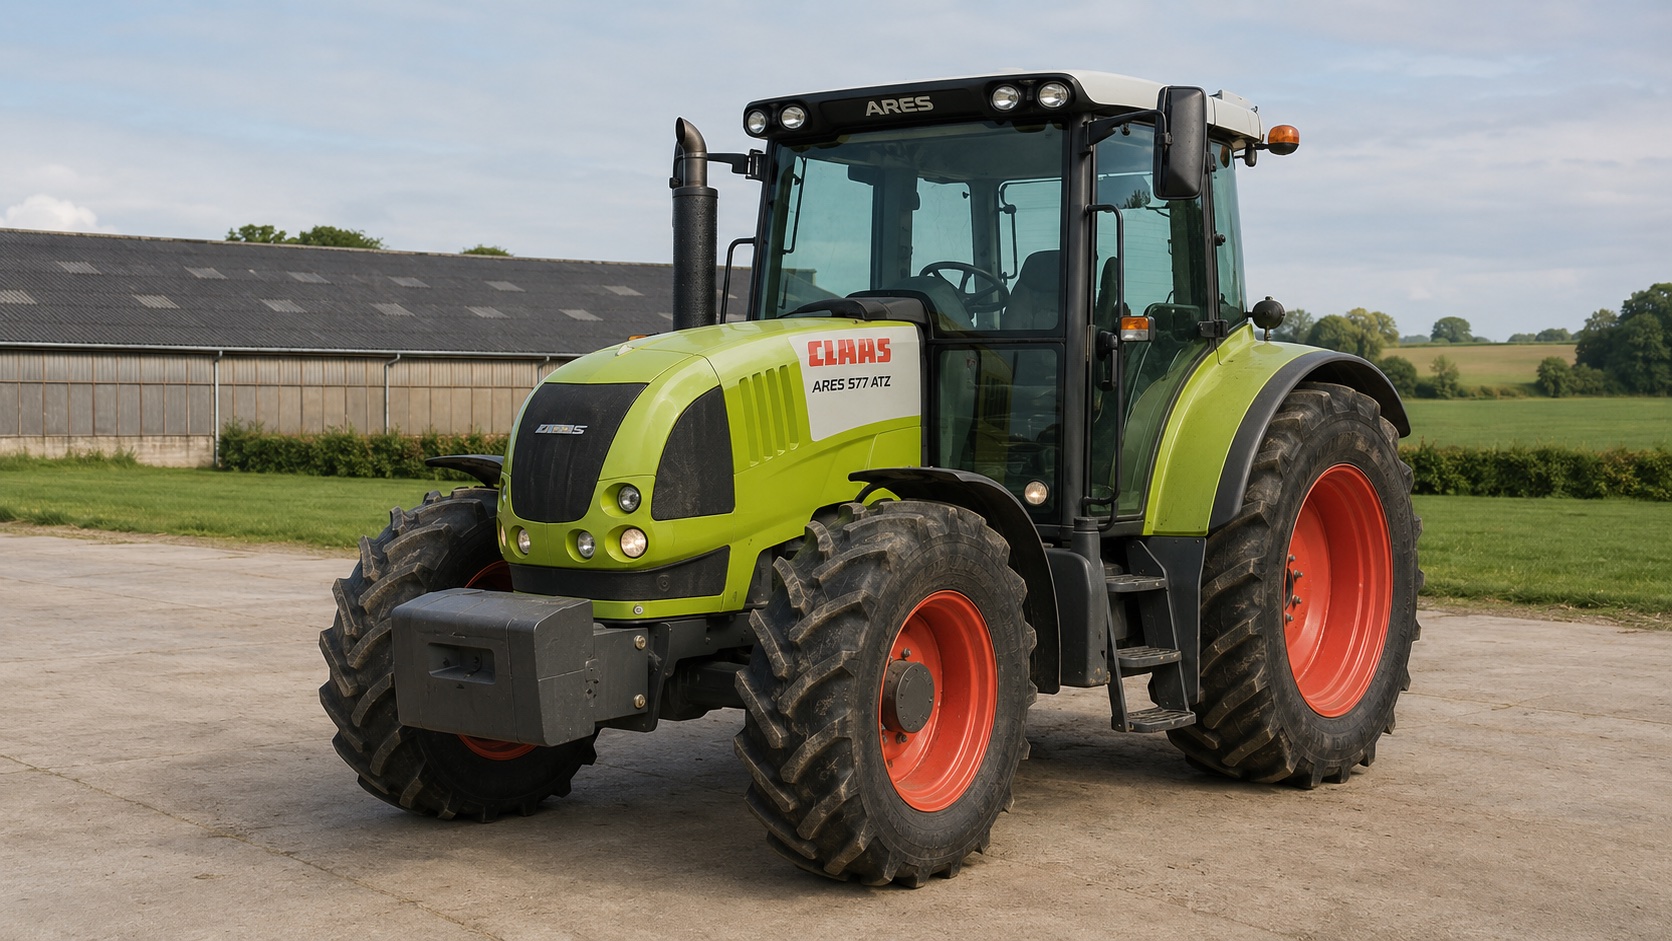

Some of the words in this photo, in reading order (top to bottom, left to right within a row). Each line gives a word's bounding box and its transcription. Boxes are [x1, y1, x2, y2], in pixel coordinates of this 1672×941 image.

[865, 95, 935, 117] ARES
[807, 337, 892, 367] CLAAS
[812, 378, 845, 393] ARES
[847, 376, 869, 390] 577
[870, 375, 891, 388] ATZ
